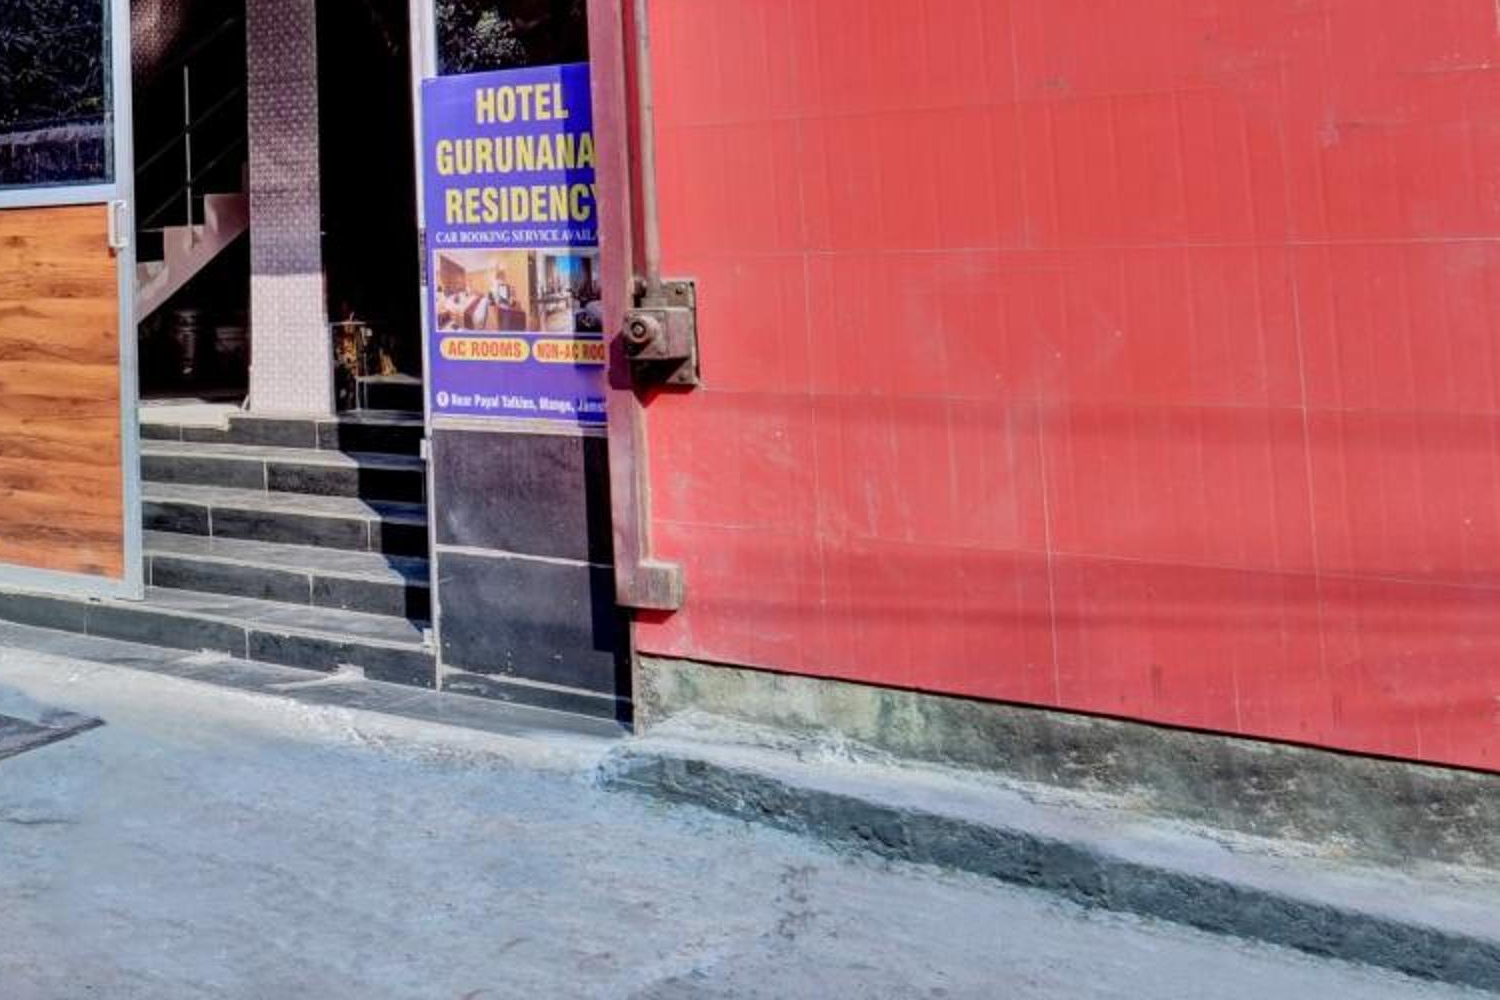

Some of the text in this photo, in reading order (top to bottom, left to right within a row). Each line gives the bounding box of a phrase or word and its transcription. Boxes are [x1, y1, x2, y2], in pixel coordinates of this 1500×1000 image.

[476, 83, 569, 124] HOTEL
[436, 132, 595, 176] GURUNANA
[445, 183, 597, 224] RESIDENC
[448, 339, 522, 358] AC ROOMS
[536, 342, 605, 361] NON-AC ROO
